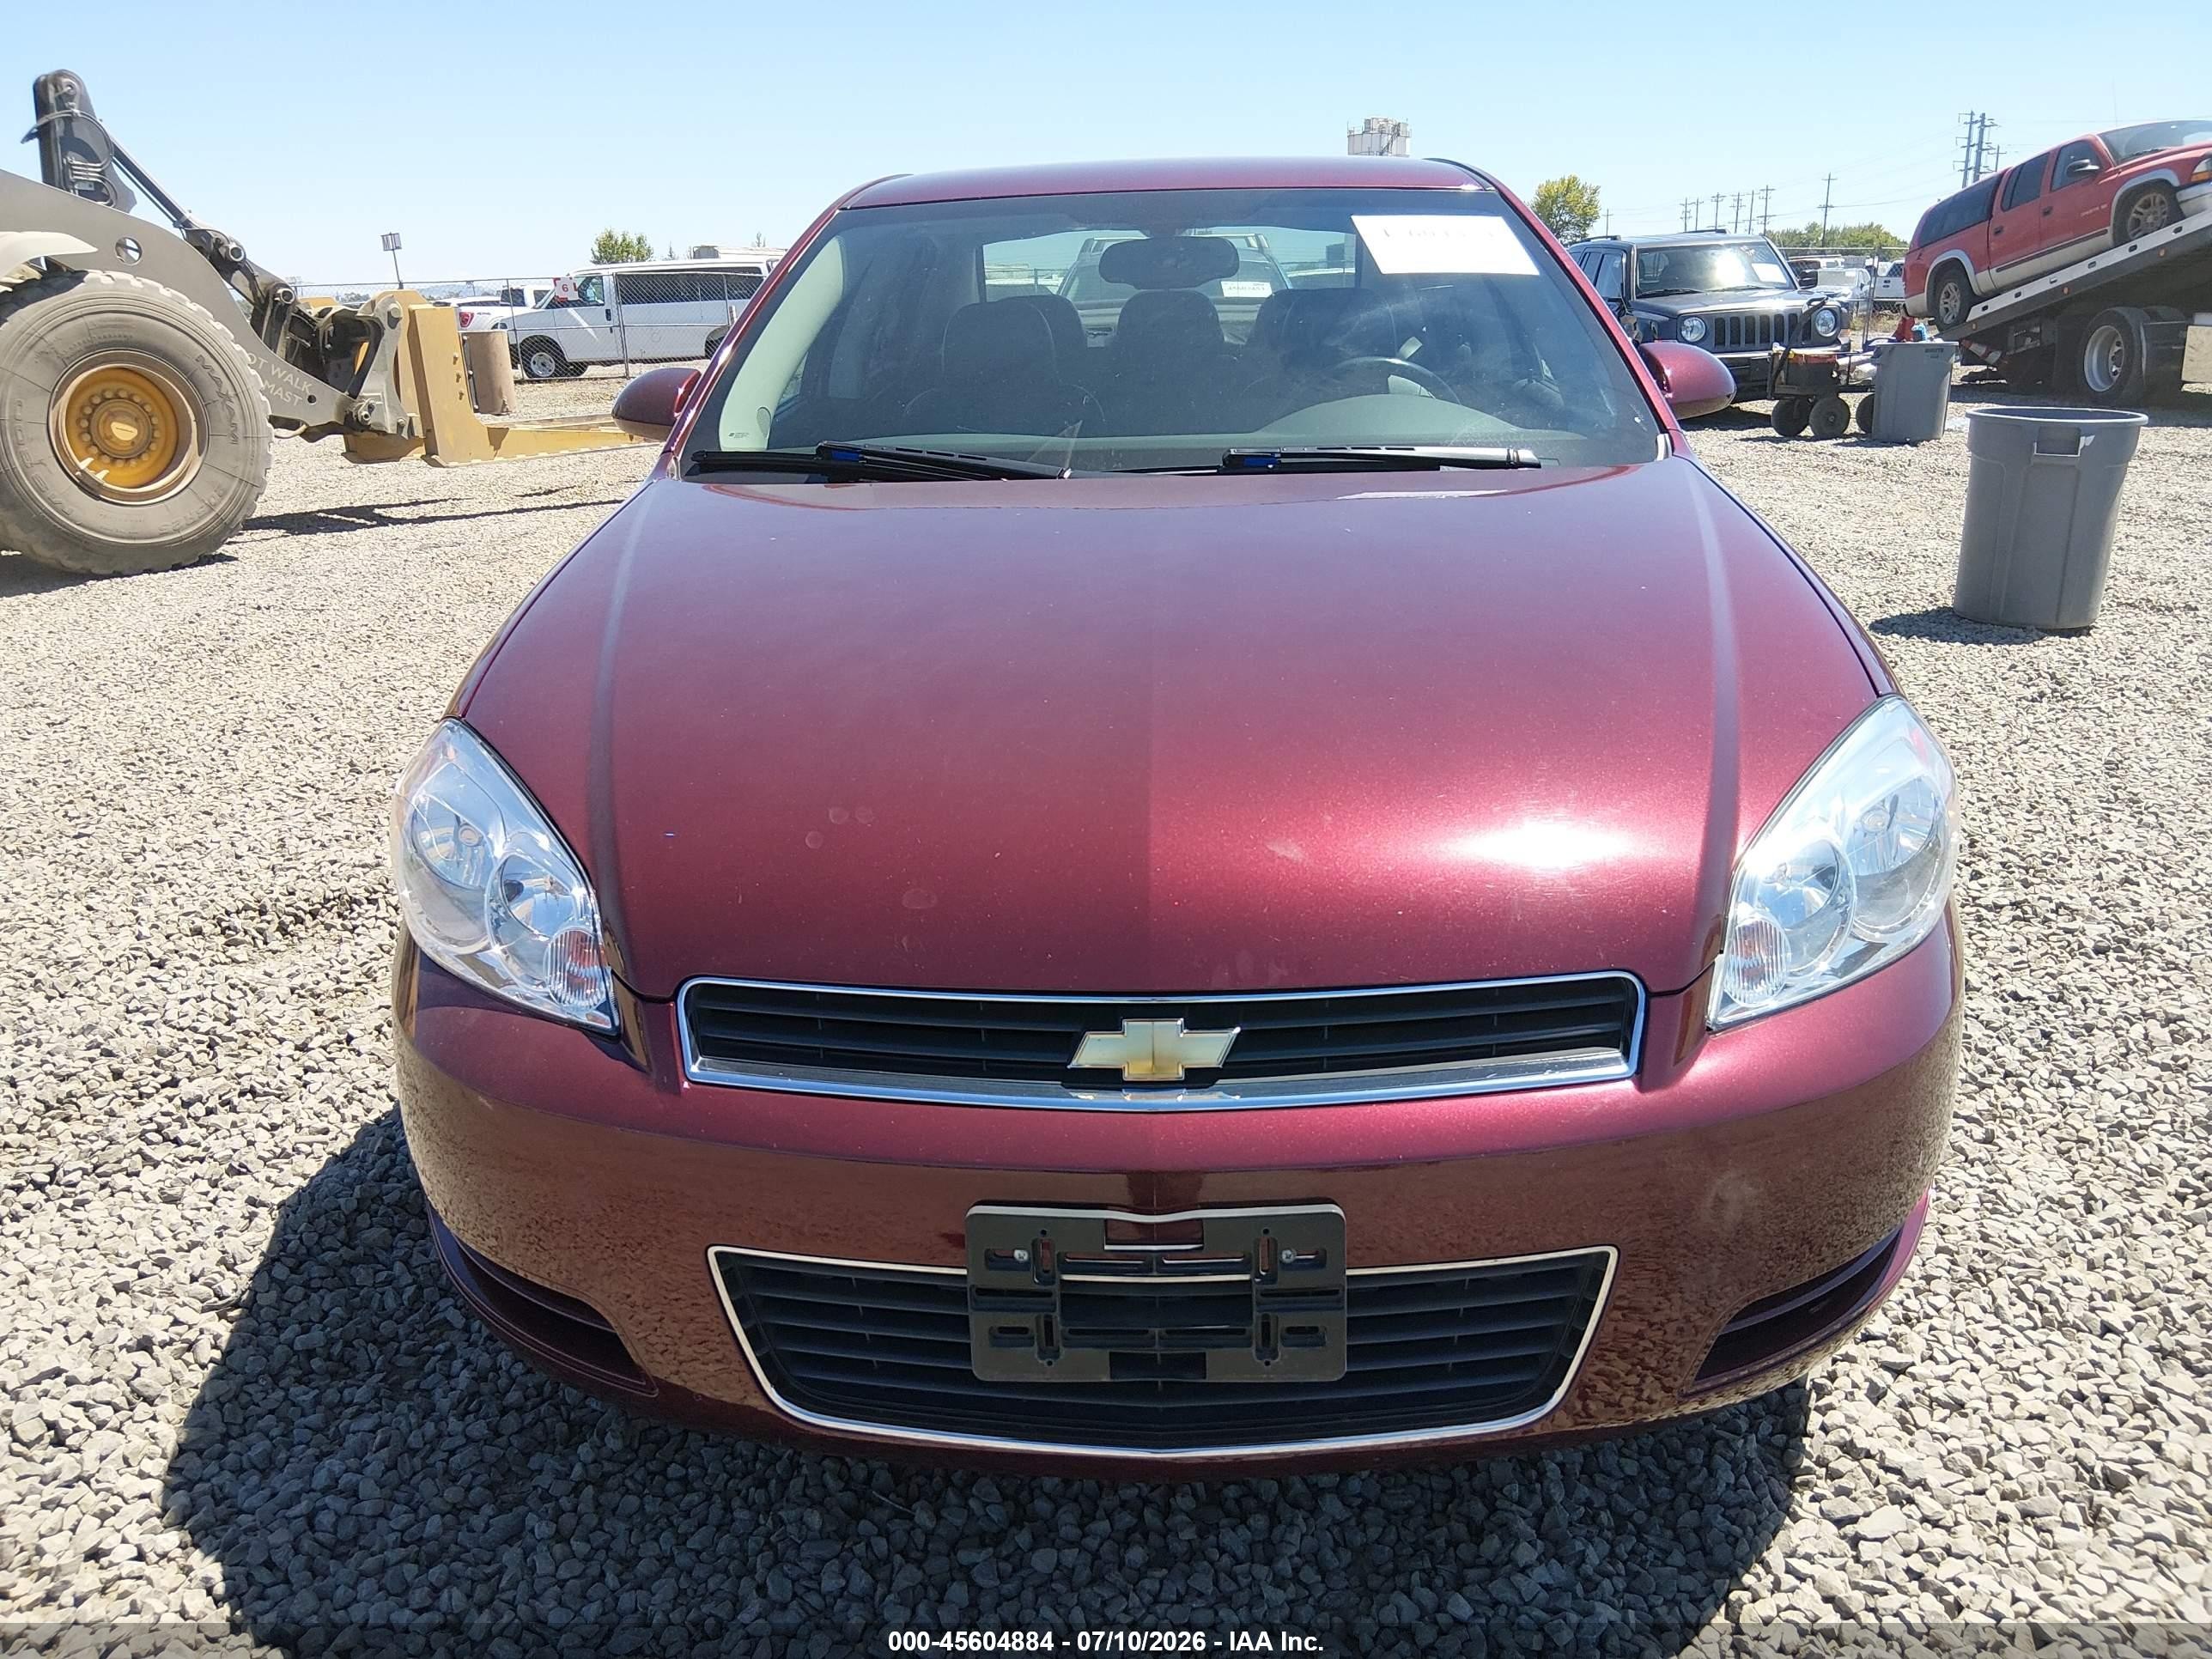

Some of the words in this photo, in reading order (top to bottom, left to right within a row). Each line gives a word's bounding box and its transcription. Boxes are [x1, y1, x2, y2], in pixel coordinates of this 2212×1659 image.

[562, 283, 569, 293] 6
[261, 380, 303, 406] MAST
[270, 363, 313, 396] WALK
[194, 354, 239, 446] MAXAM
